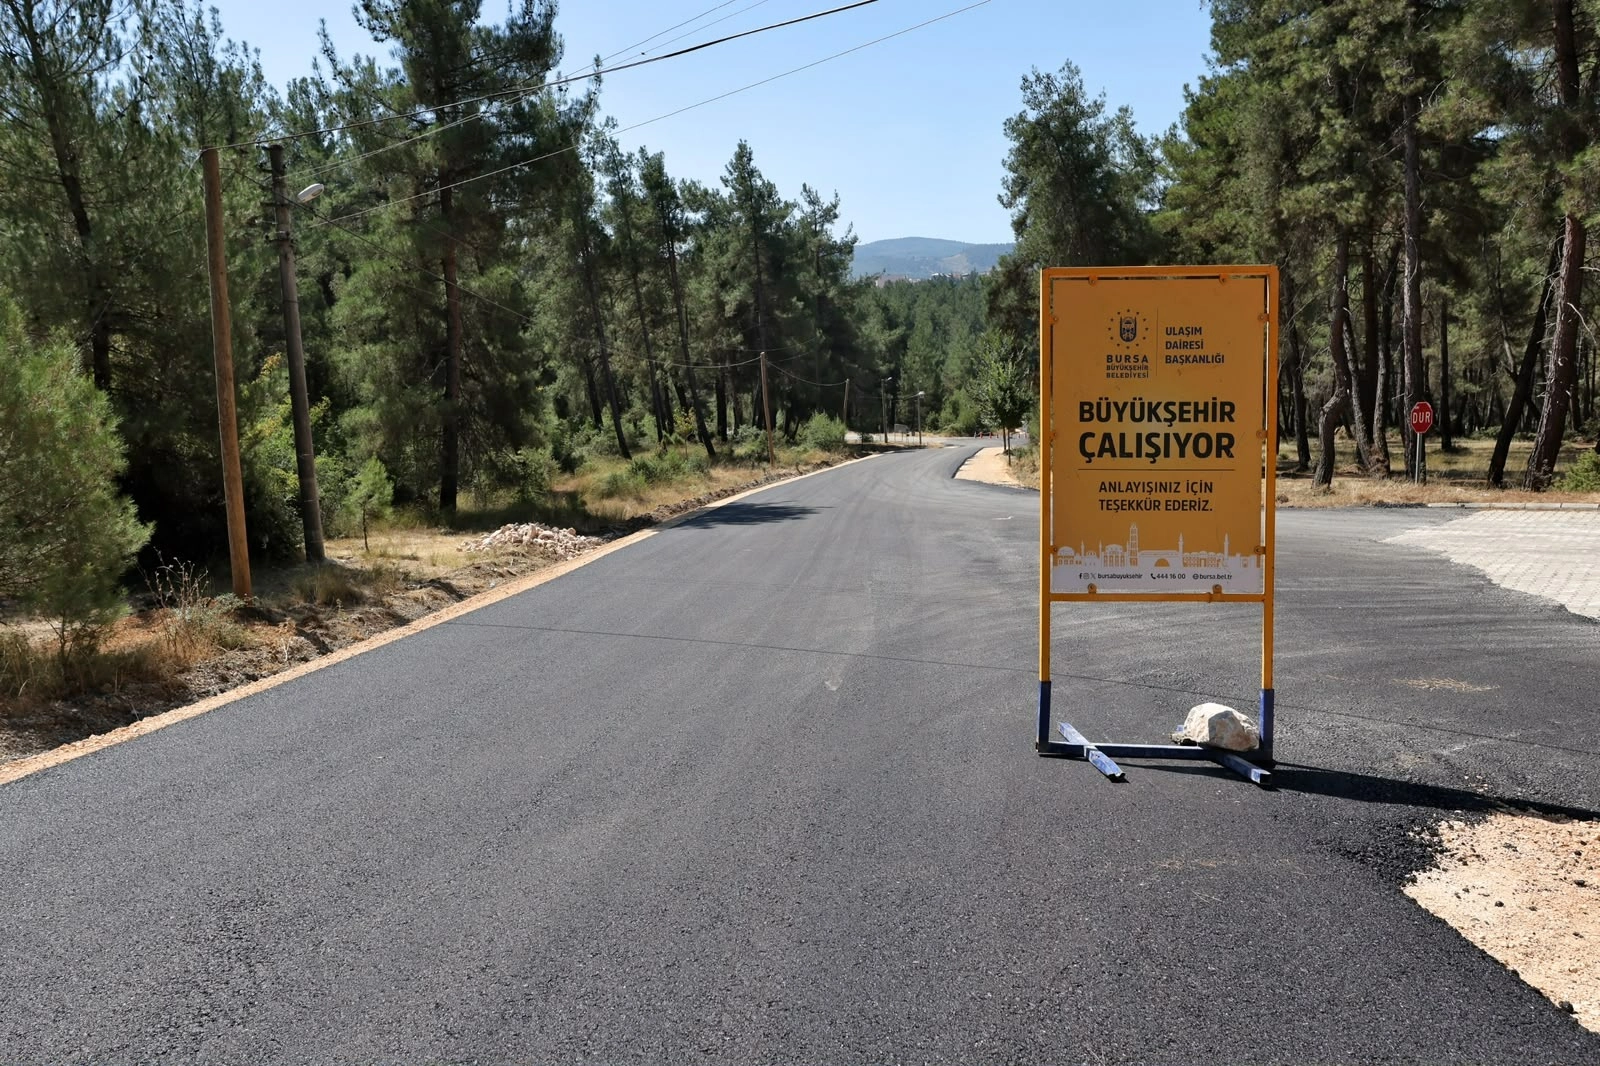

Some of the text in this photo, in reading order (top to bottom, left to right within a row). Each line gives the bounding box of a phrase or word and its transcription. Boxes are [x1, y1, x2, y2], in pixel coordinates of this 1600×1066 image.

[1166, 326, 1202, 337] ULAŞIM
[1165, 339, 1203, 349] DAİRESİ
[1106, 354, 1148, 363] BURSA
[1165, 353, 1224, 365] BAŞKANLIĞI
[1079, 397, 1235, 427] BÜYÜKŞEHİR
[1413, 412, 1430, 423] DUR
[1079, 432, 1234, 463] ÇALIŞIYOR
[1099, 479, 1213, 496] ANLAYIŞINIZ İÇİN
[1099, 497, 1213, 513] TEŞEKKÜR EDERİZ.
